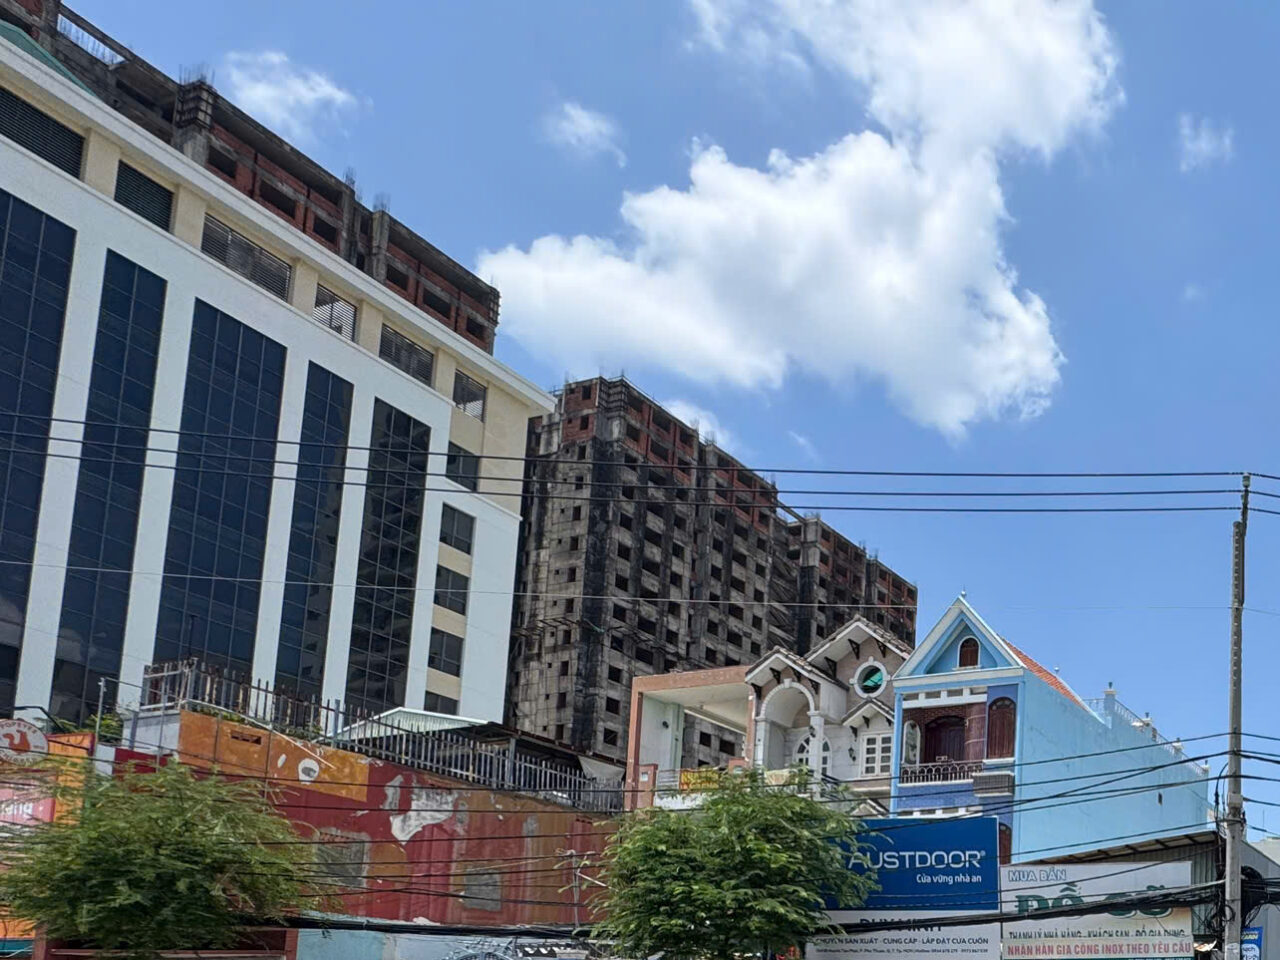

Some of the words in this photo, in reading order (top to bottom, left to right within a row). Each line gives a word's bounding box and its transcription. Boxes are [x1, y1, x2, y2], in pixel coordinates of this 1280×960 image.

[916, 873, 931, 883] Cửa
[932, 873, 953, 885] vững
[955, 872, 970, 883] nhà
[971, 875, 982, 883] an
[1008, 869, 1036, 882] MUA
[1056, 944, 1072, 955] GIA
[1074, 942, 1099, 955] CÔNG
[1102, 943, 1124, 955] INOX
[1126, 943, 1149, 954] THEO
[1152, 940, 1169, 953] YÊU
